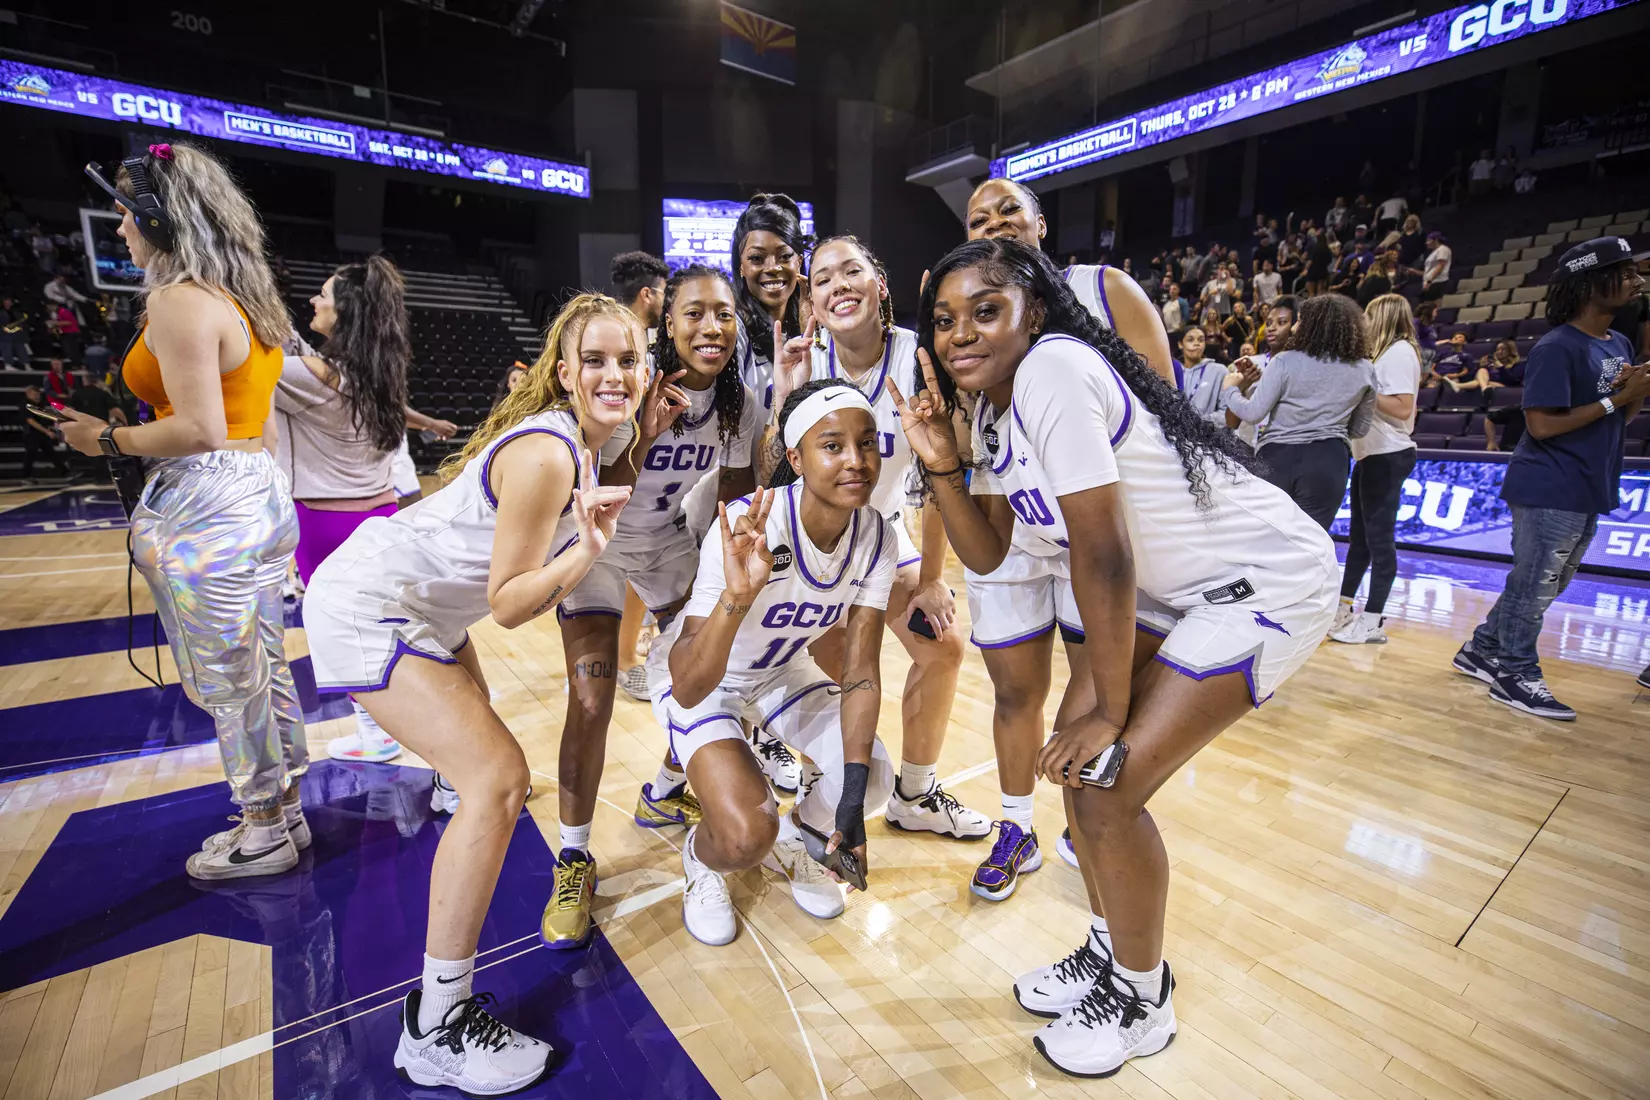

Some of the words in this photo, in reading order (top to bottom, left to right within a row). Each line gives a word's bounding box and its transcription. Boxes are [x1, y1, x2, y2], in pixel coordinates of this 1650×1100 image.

[170, 10, 213, 36] 200
[1448, 0, 1568, 52] GCU
[111, 92, 183, 126] GCU
[1188, 100, 1216, 121] OCT
[1218, 92, 1237, 112] 28
[1264, 75, 1289, 97] PM
[231, 116, 272, 135] MEN'S
[273, 124, 350, 148] BASKETBALL
[1010, 148, 1057, 176] WOMEN'S
[1058, 126, 1132, 161] BASKETBALL
[541, 168, 585, 193] GCU
[643, 443, 715, 471] GCU
[1234, 585, 1246, 595] M
[761, 601, 844, 628] GCU
[748, 635, 812, 669] 11
